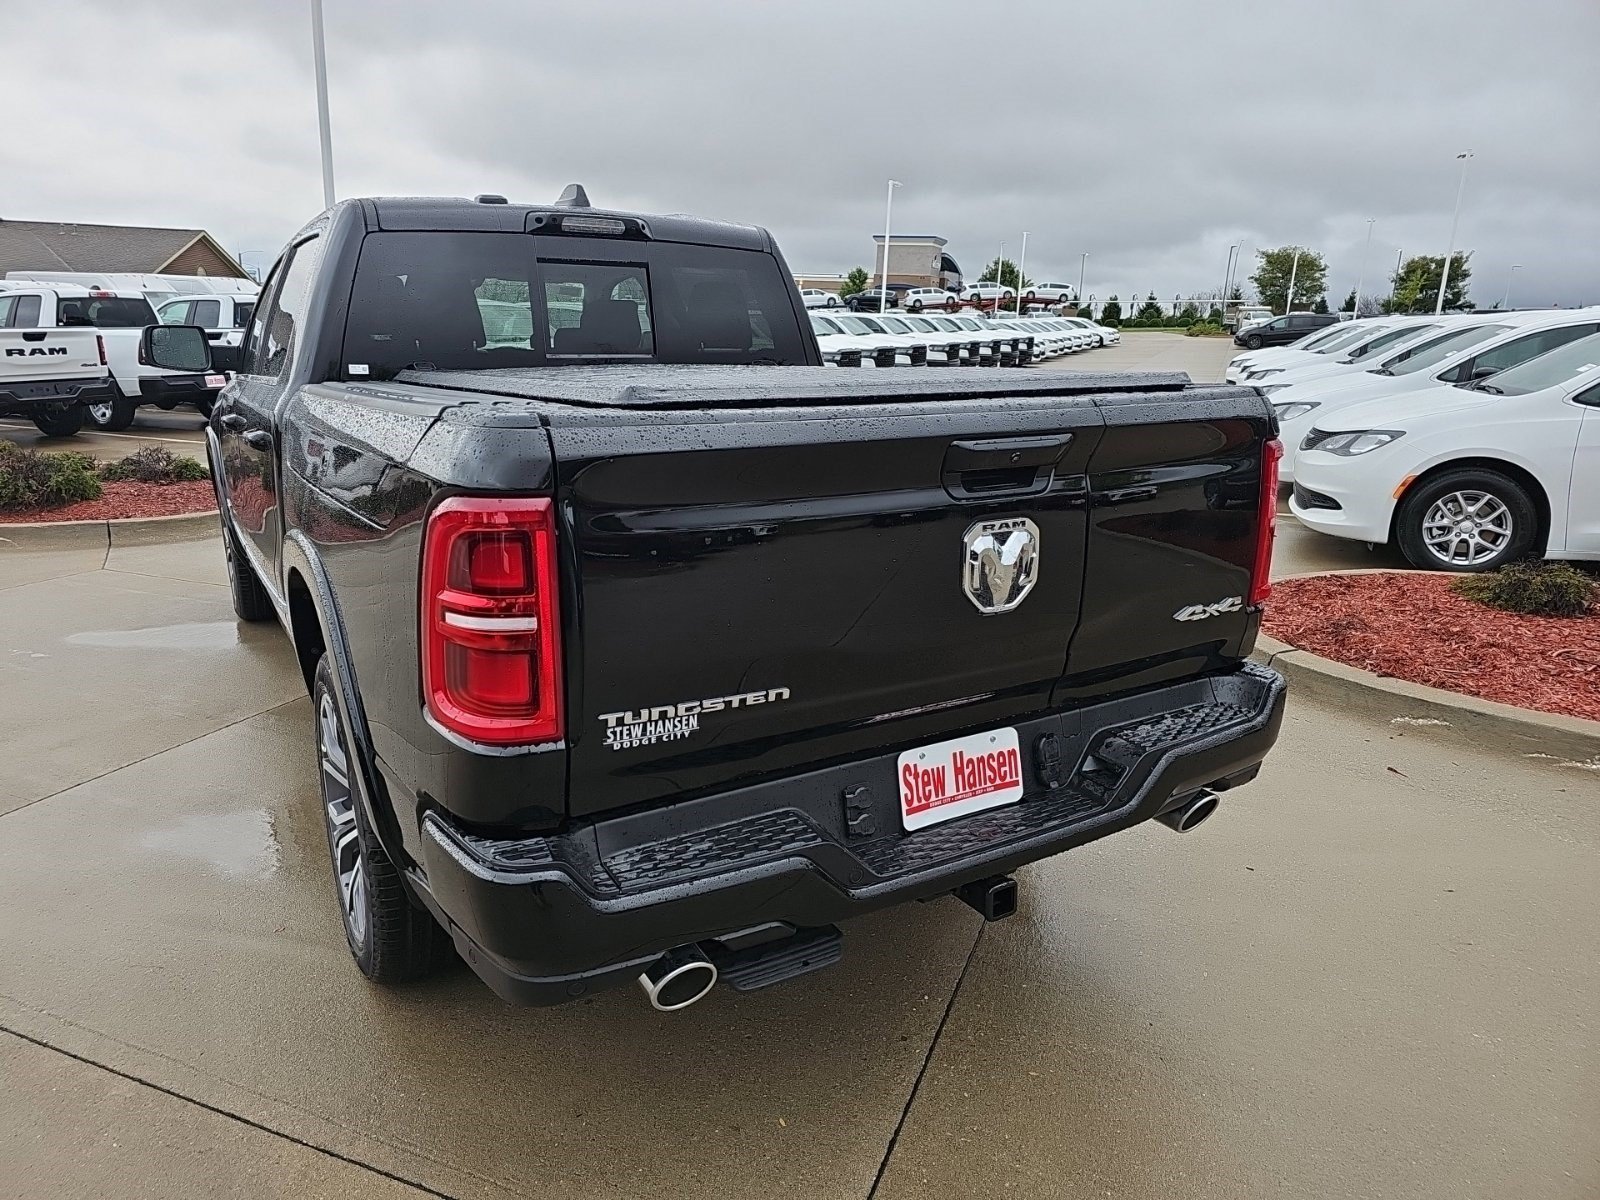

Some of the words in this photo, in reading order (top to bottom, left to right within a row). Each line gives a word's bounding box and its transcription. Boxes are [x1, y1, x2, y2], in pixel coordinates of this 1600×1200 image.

[5, 347, 68, 357] RAM
[982, 520, 1026, 532] RAM
[598, 687, 790, 727] TUNGSTEN
[606, 724, 643, 743] STEW
[647, 714, 698, 736] HANSEN
[613, 736, 657, 750] DODGE
[662, 730, 691, 742] CITY
[902, 763, 946, 808] Stew
[952, 748, 1019, 793] Hansen
